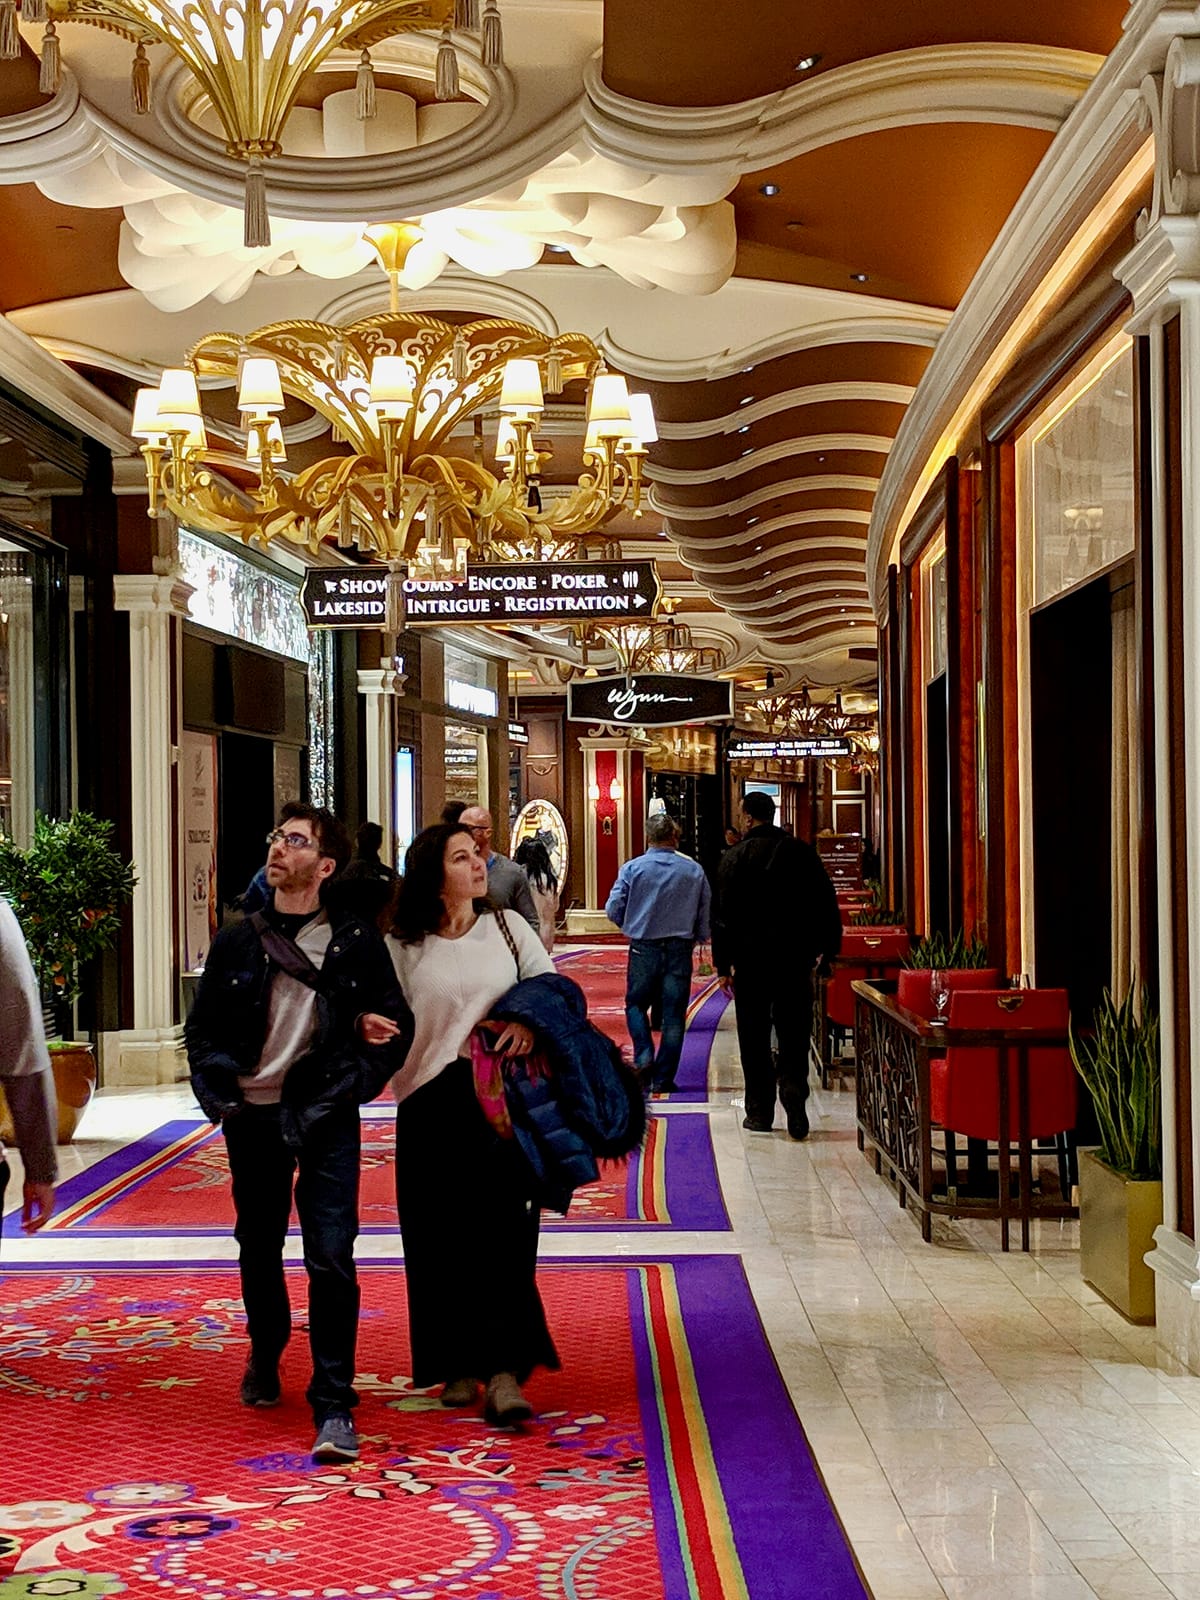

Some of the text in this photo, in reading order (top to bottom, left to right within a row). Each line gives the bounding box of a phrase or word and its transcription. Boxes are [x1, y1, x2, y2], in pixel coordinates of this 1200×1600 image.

[340, 574, 608, 594] SHOWOOMS ENCORE POKER
[314, 596, 629, 616] LAKESID INTRIGUE REGISTRATION
